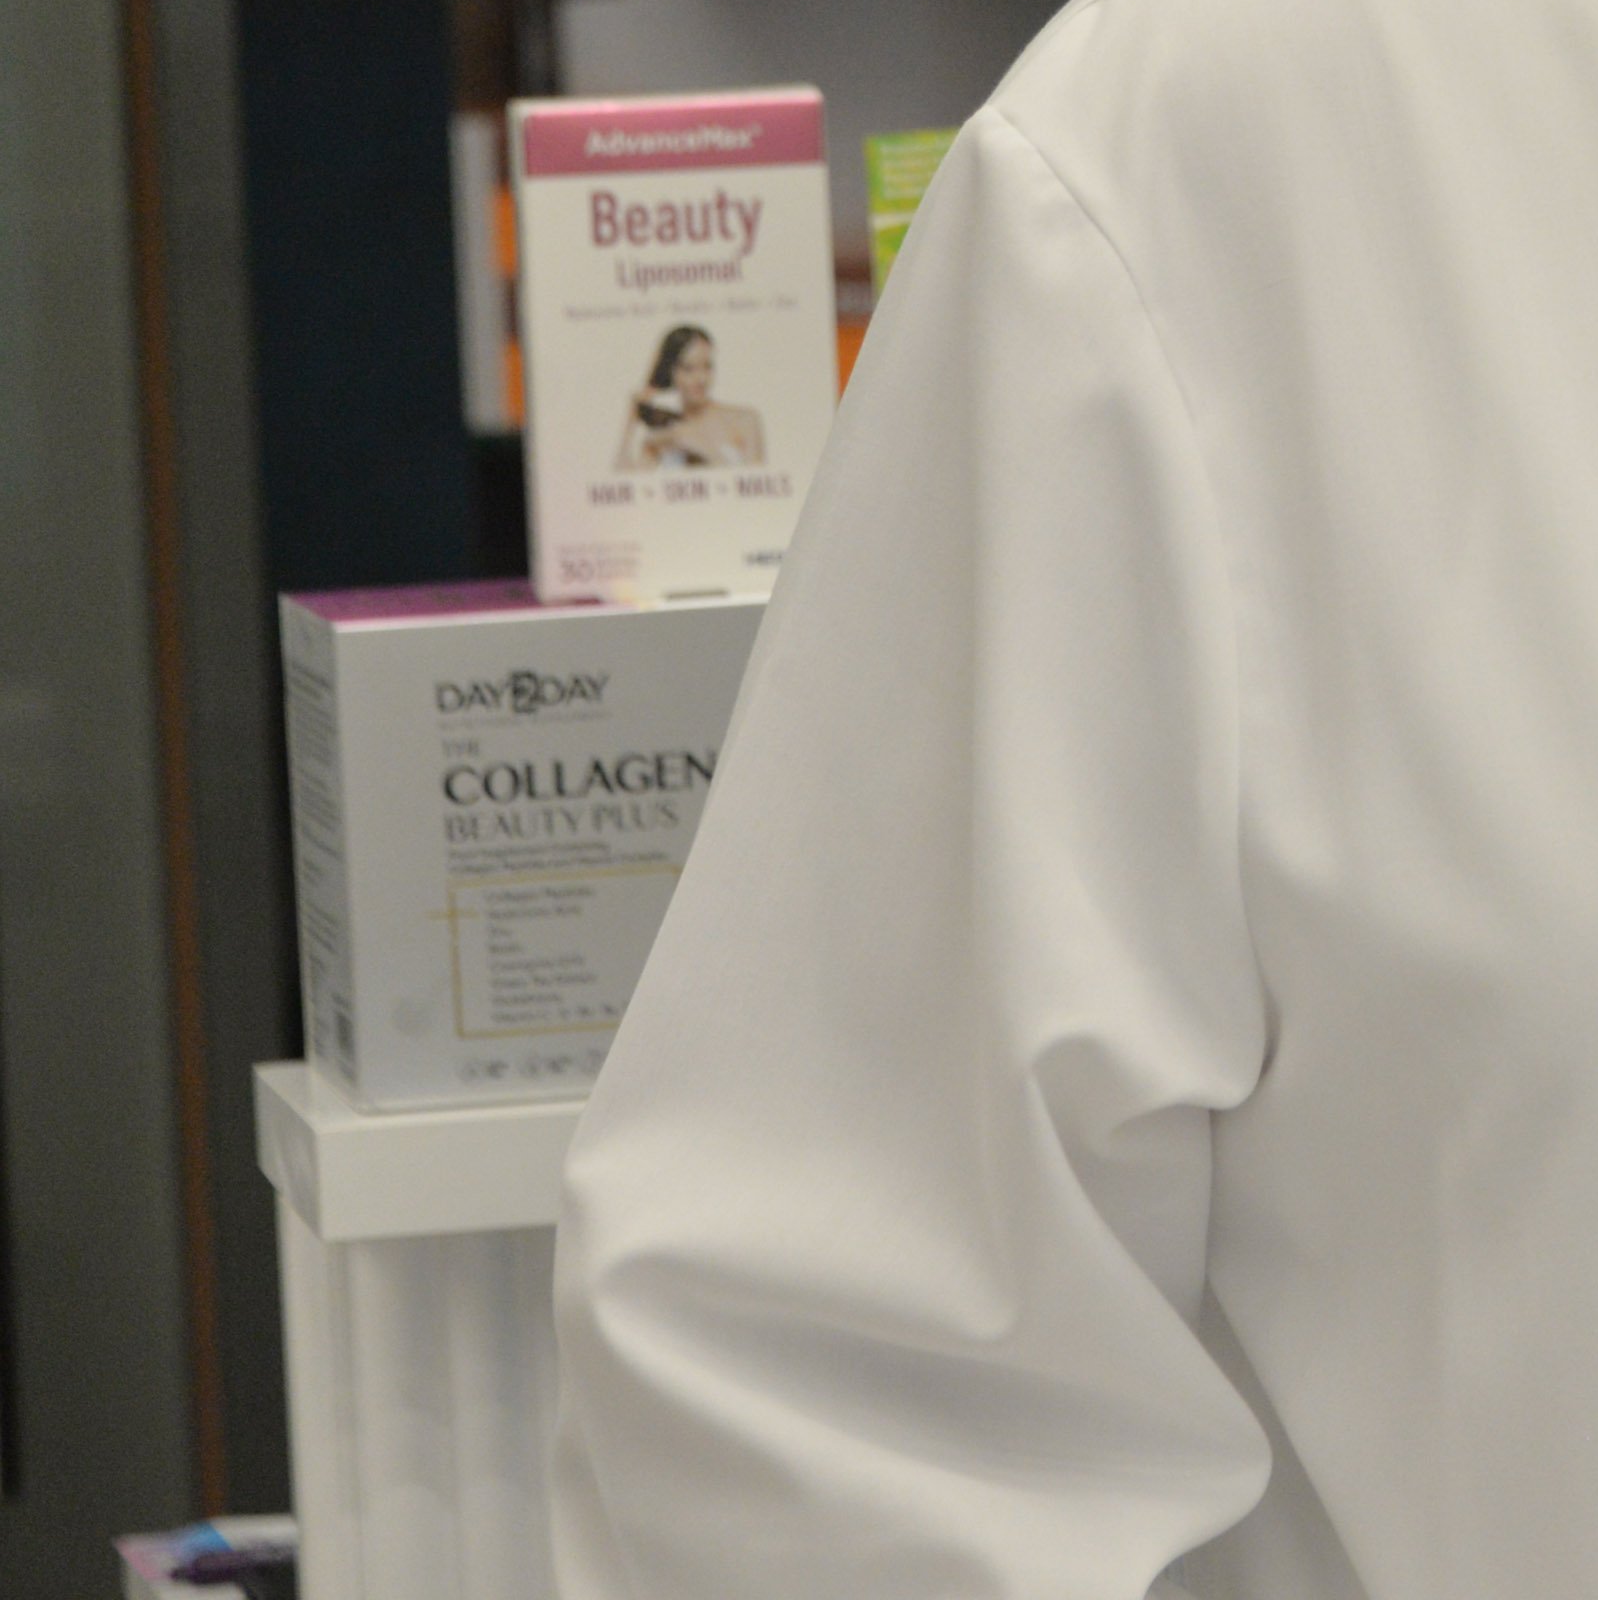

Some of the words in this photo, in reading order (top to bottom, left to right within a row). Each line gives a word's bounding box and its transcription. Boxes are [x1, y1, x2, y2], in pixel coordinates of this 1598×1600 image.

[591, 188, 762, 256] Beauty
[616, 259, 743, 292] Liposomal
[590, 481, 634, 506] HAIR
[664, 476, 709, 503] SKIN
[736, 472, 791, 499] NAILS
[443, 751, 719, 805] COLLAGEN
[446, 808, 579, 842] BEAUTY
[592, 801, 681, 833] PLUS
